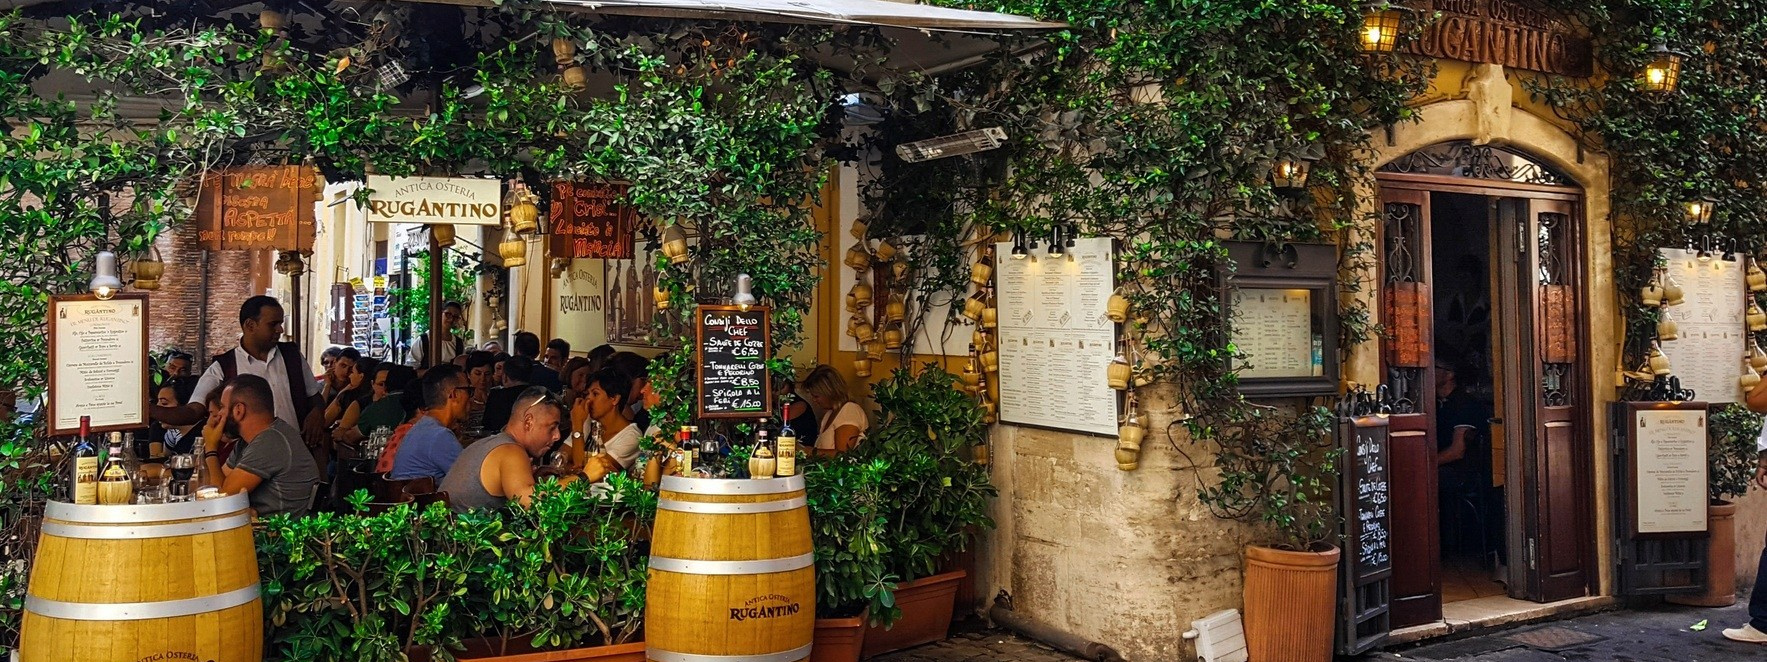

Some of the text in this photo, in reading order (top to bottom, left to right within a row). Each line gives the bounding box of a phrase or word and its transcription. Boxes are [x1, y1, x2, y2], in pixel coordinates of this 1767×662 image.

[395, 182, 476, 200] ANTICA OSTERIA
[371, 198, 498, 219] RUGANTINO
[578, 268, 598, 290] OSTERIA
[560, 292, 602, 314] RUGANTINO
[745, 596, 767, 606] ANTICA
[729, 602, 800, 622] RUGANTINO
[166, 651, 199, 662] OSTERIA
